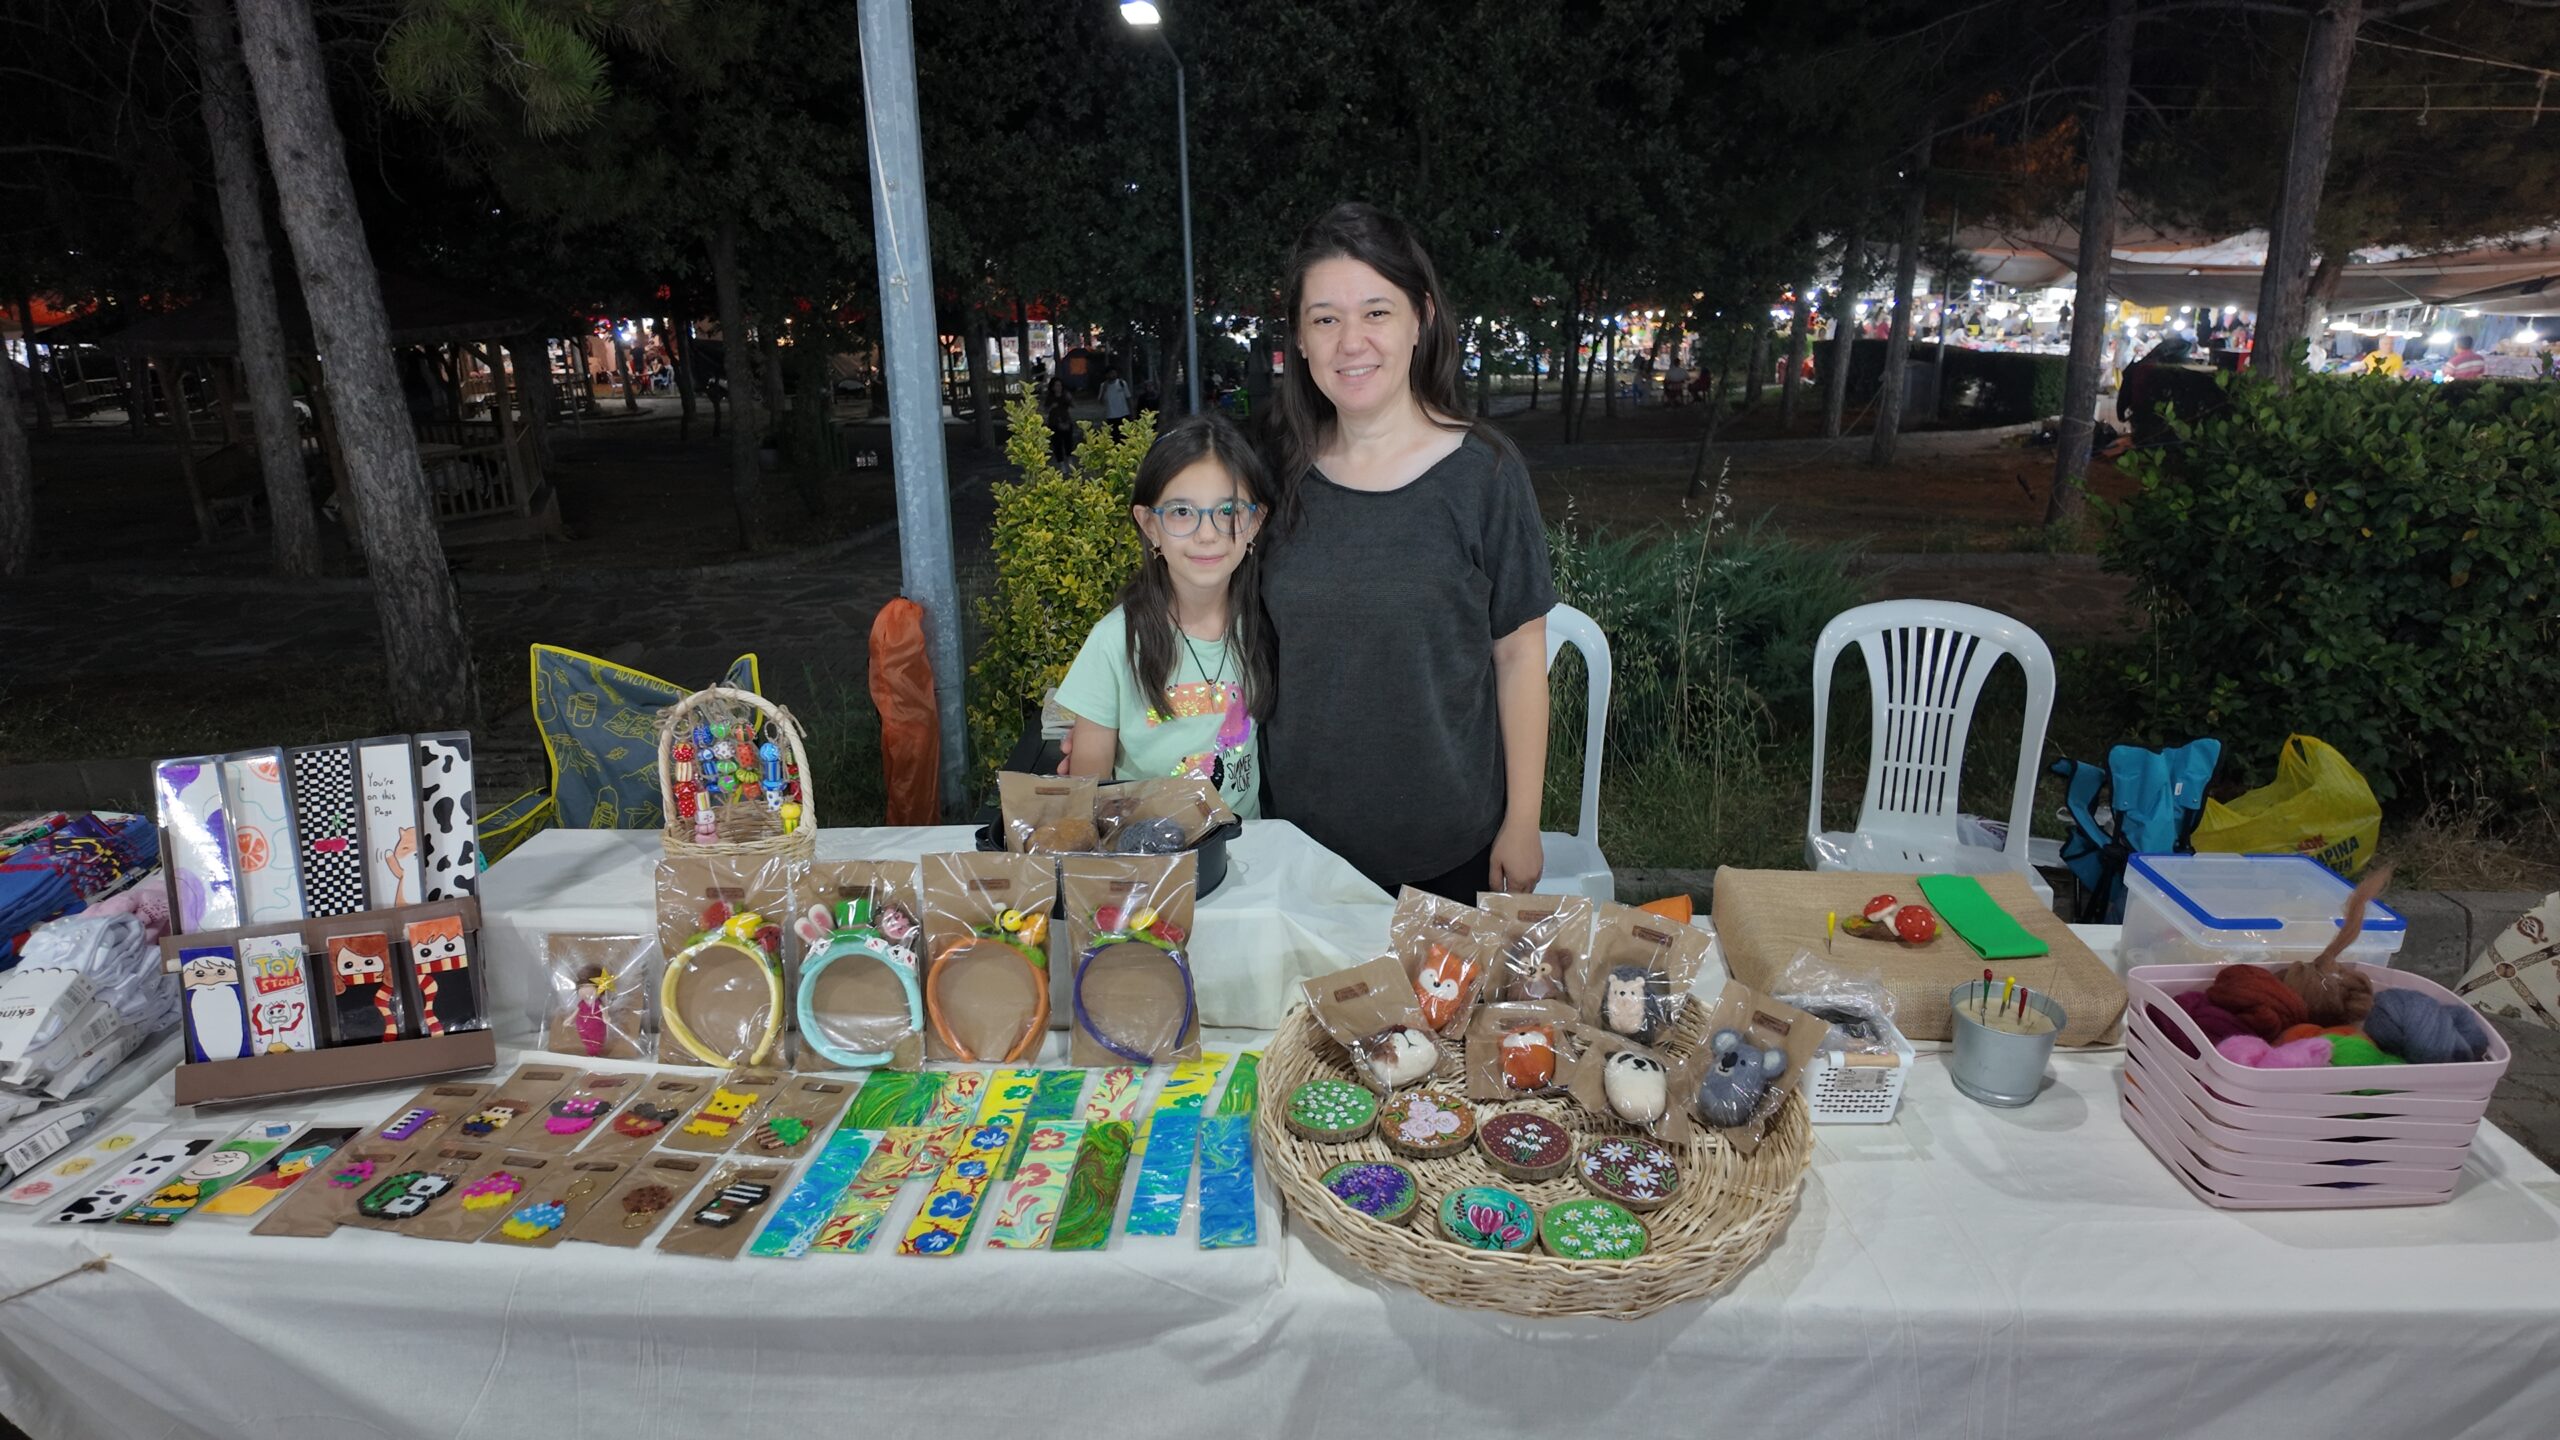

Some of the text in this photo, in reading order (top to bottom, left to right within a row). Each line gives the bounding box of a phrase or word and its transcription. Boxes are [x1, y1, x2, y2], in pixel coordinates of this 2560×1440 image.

[367, 771, 394, 787] You're
[382, 788, 396, 801] this
[249, 947, 303, 978] TOY
